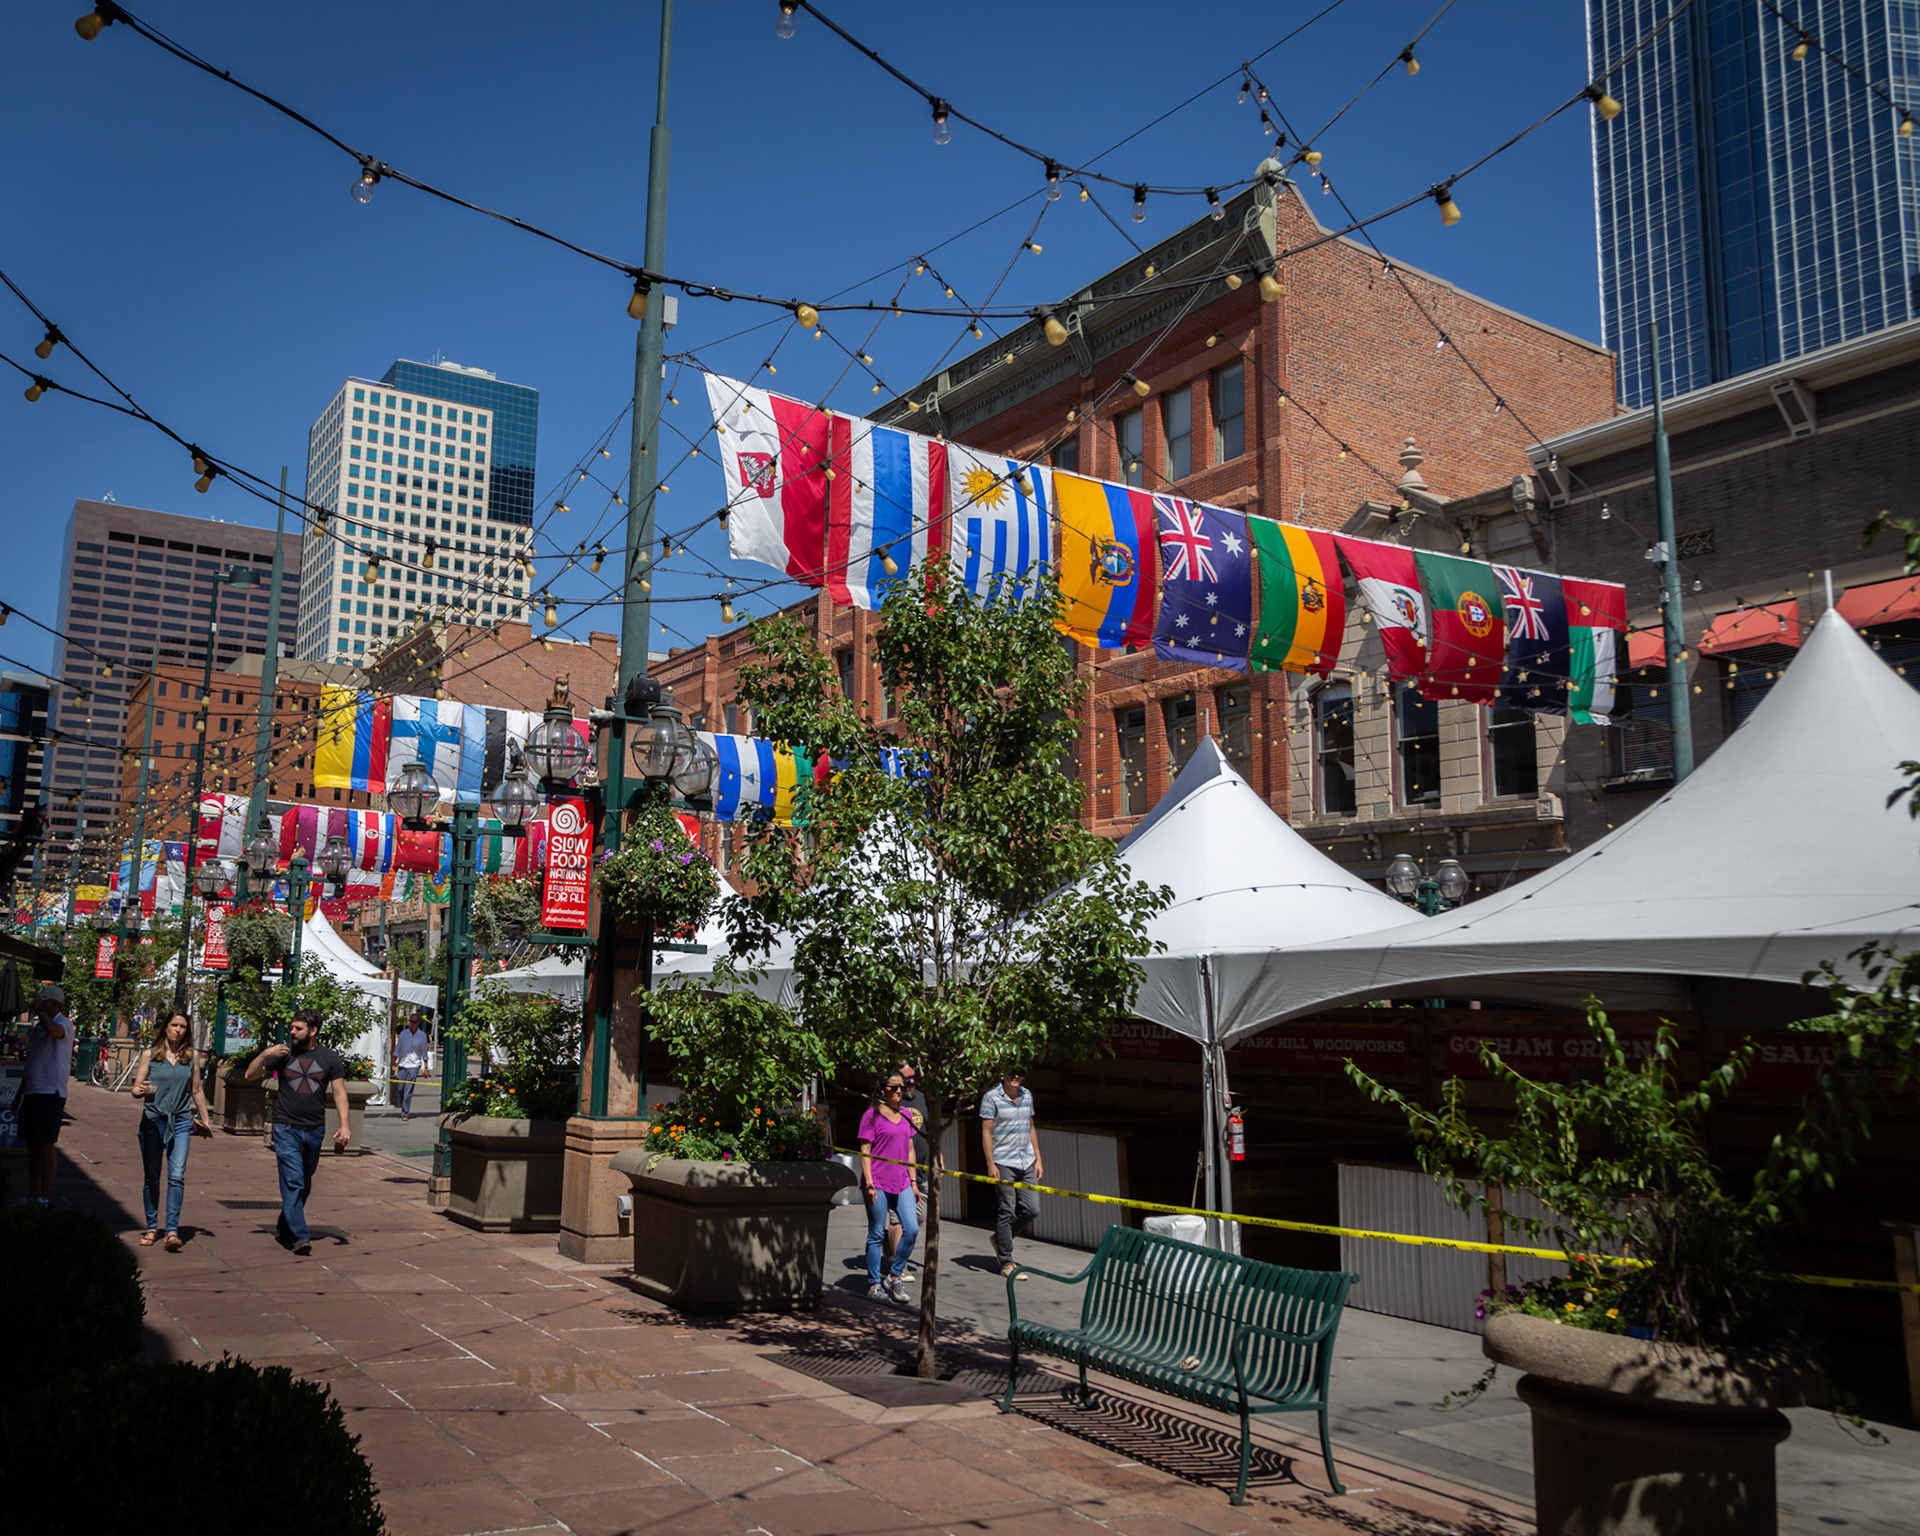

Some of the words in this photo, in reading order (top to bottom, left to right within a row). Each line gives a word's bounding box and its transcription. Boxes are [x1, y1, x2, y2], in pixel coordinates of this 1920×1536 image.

[551, 836, 589, 854] SLOW
[550, 852, 588, 869] FOOD
[549, 868, 587, 881] NATIONS
[547, 891, 568, 902] FOR
[569, 892, 586, 904] ALL
[1105, 1023, 1180, 1040] TEATULIA
[1239, 1037, 1274, 1049] PARK
[1278, 1037, 1308, 1050] HILL
[1312, 1038, 1406, 1053] WOODWORKS
